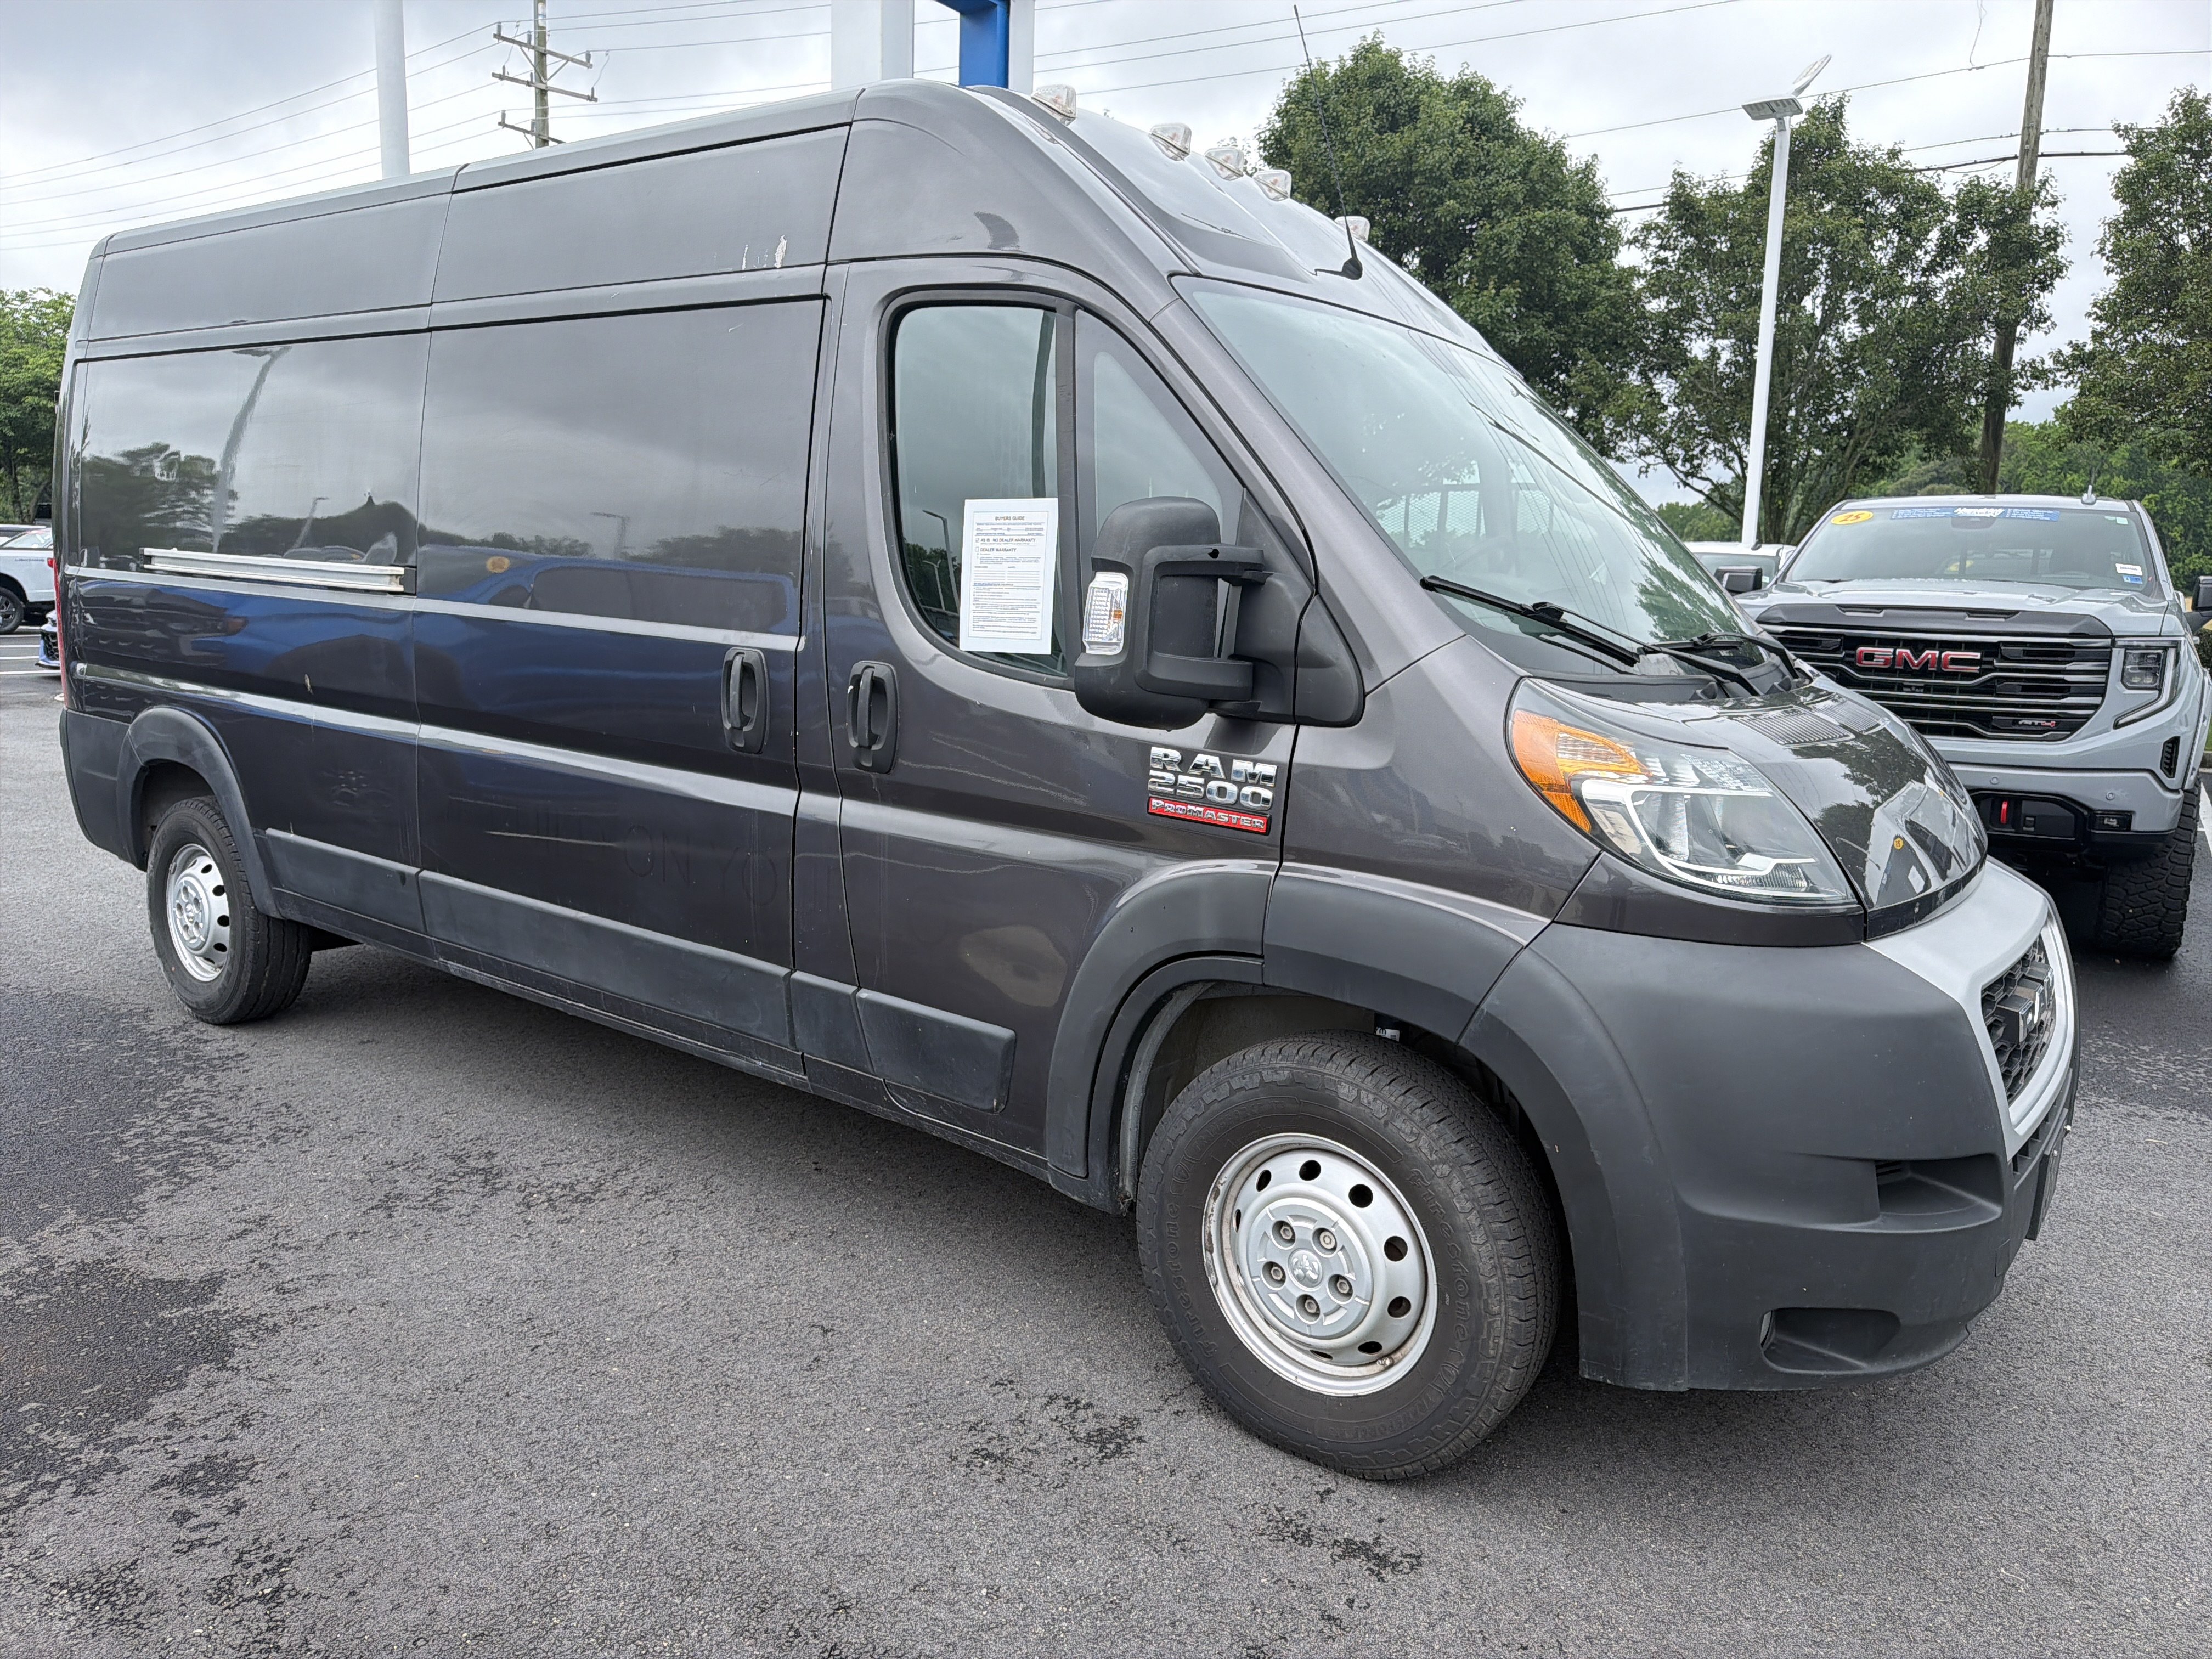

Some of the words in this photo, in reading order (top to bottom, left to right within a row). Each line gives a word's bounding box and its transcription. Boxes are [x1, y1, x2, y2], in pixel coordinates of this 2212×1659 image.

[1855, 646, 1981, 674] GMC
[1150, 746, 1277, 787] RAM
[1148, 770, 1273, 811] 2500
[1152, 799, 1265, 829] PROMASTER
